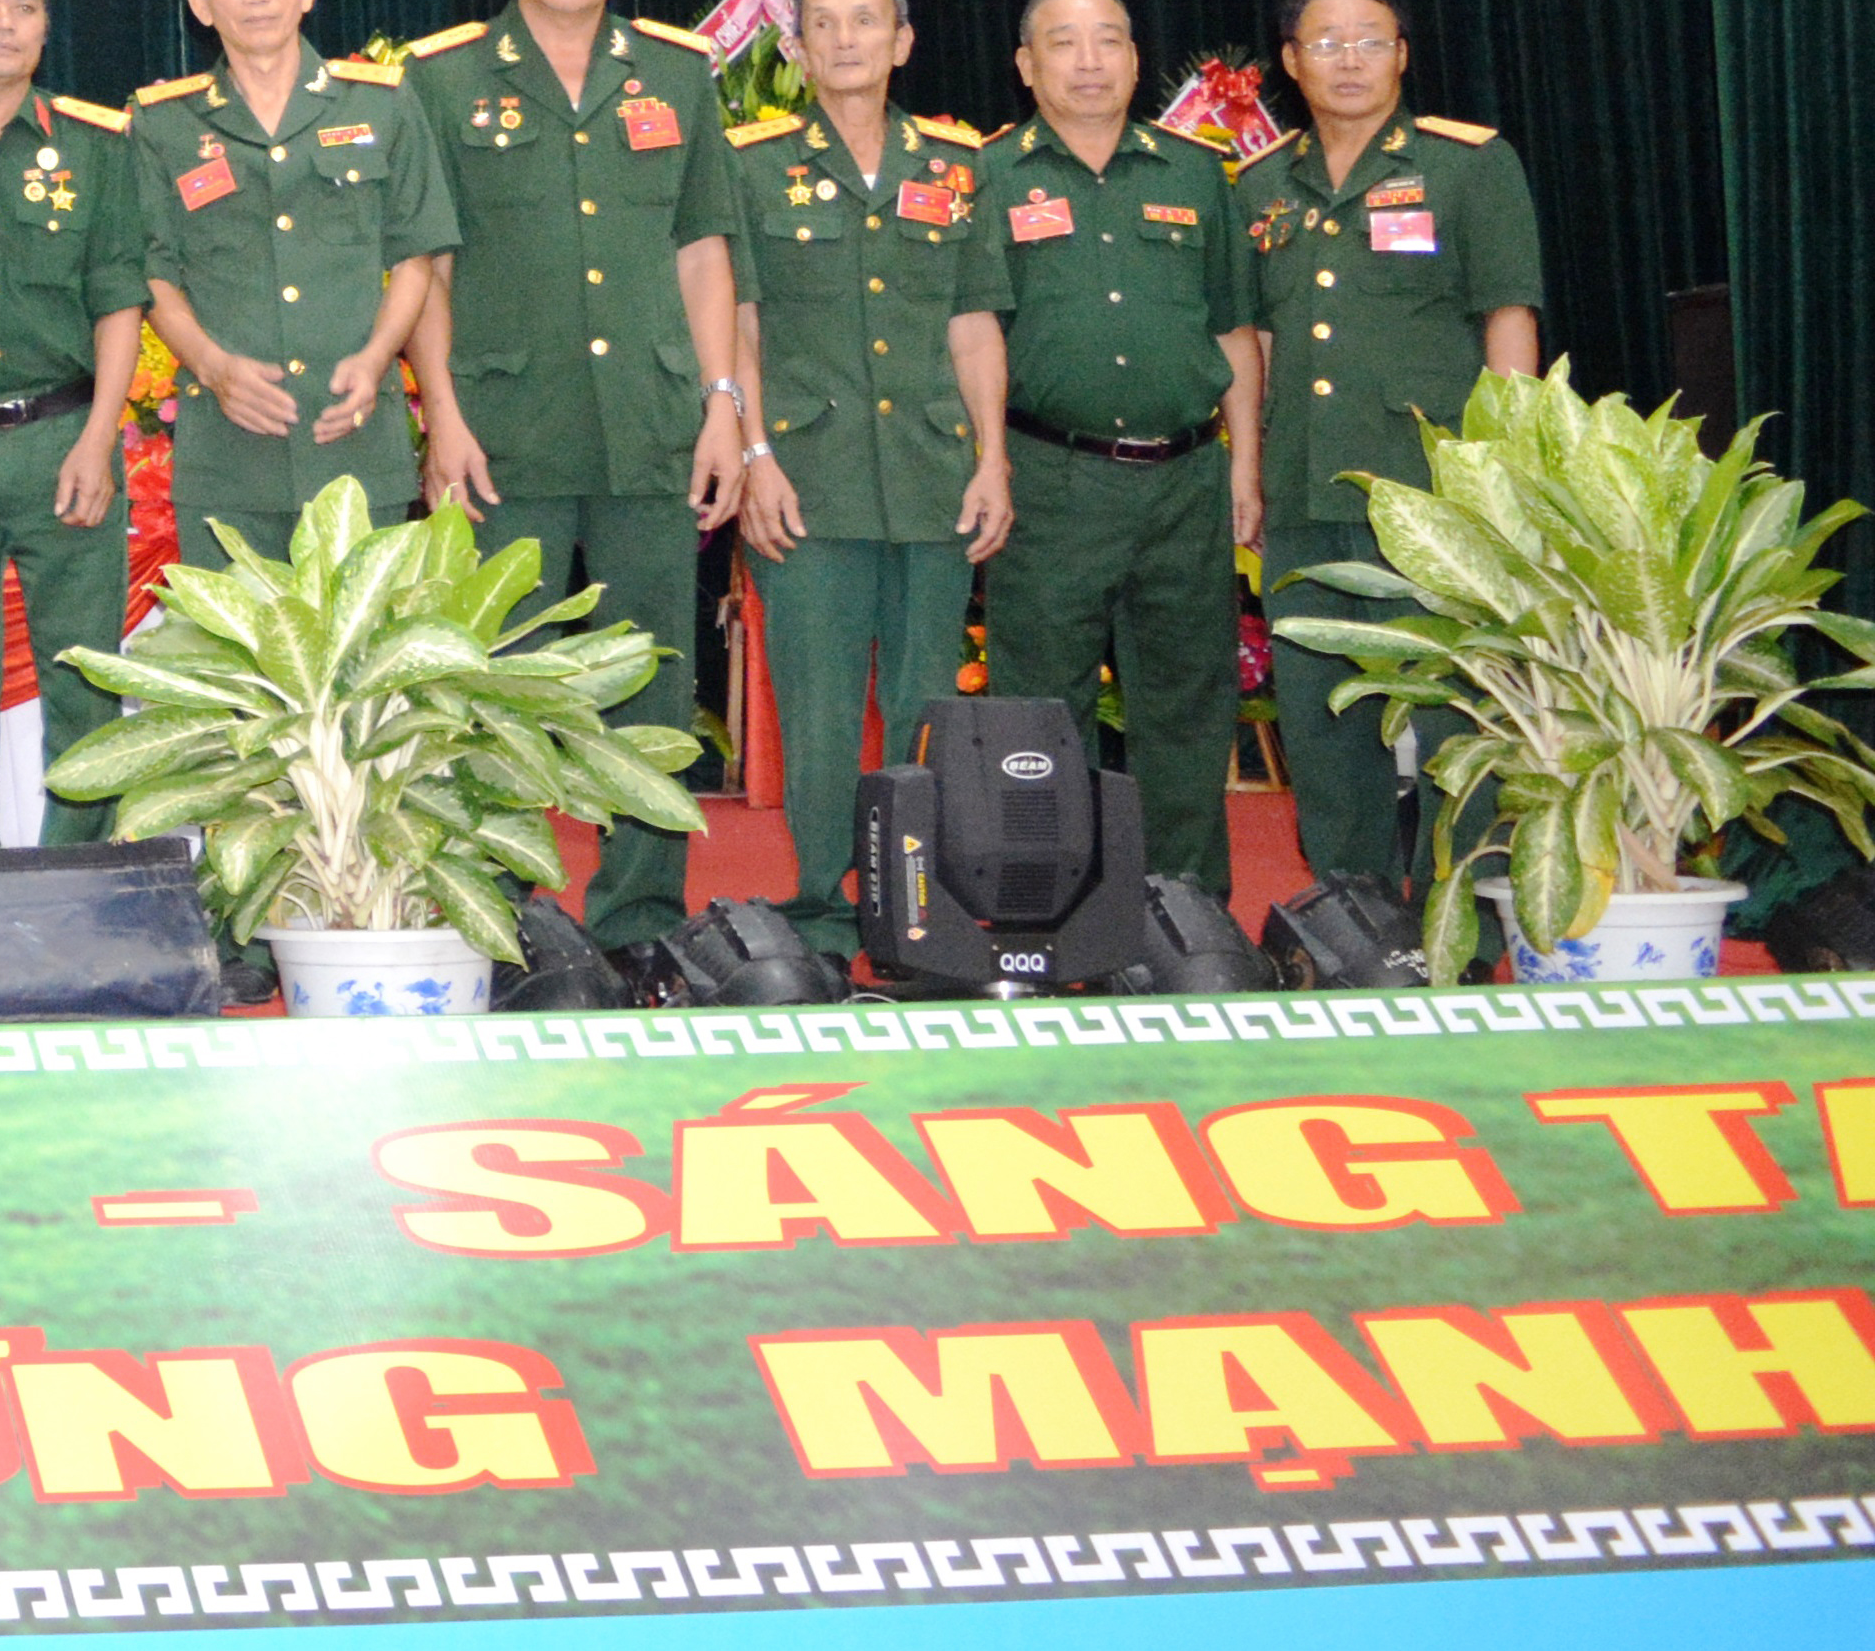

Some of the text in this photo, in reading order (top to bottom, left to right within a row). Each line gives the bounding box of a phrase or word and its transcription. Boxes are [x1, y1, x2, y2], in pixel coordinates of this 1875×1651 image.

[1009, 760, 1049, 772] BEAM
[373, 1081, 1524, 1261] SÁNG
[746, 1288, 1875, 1492] MẠNH
